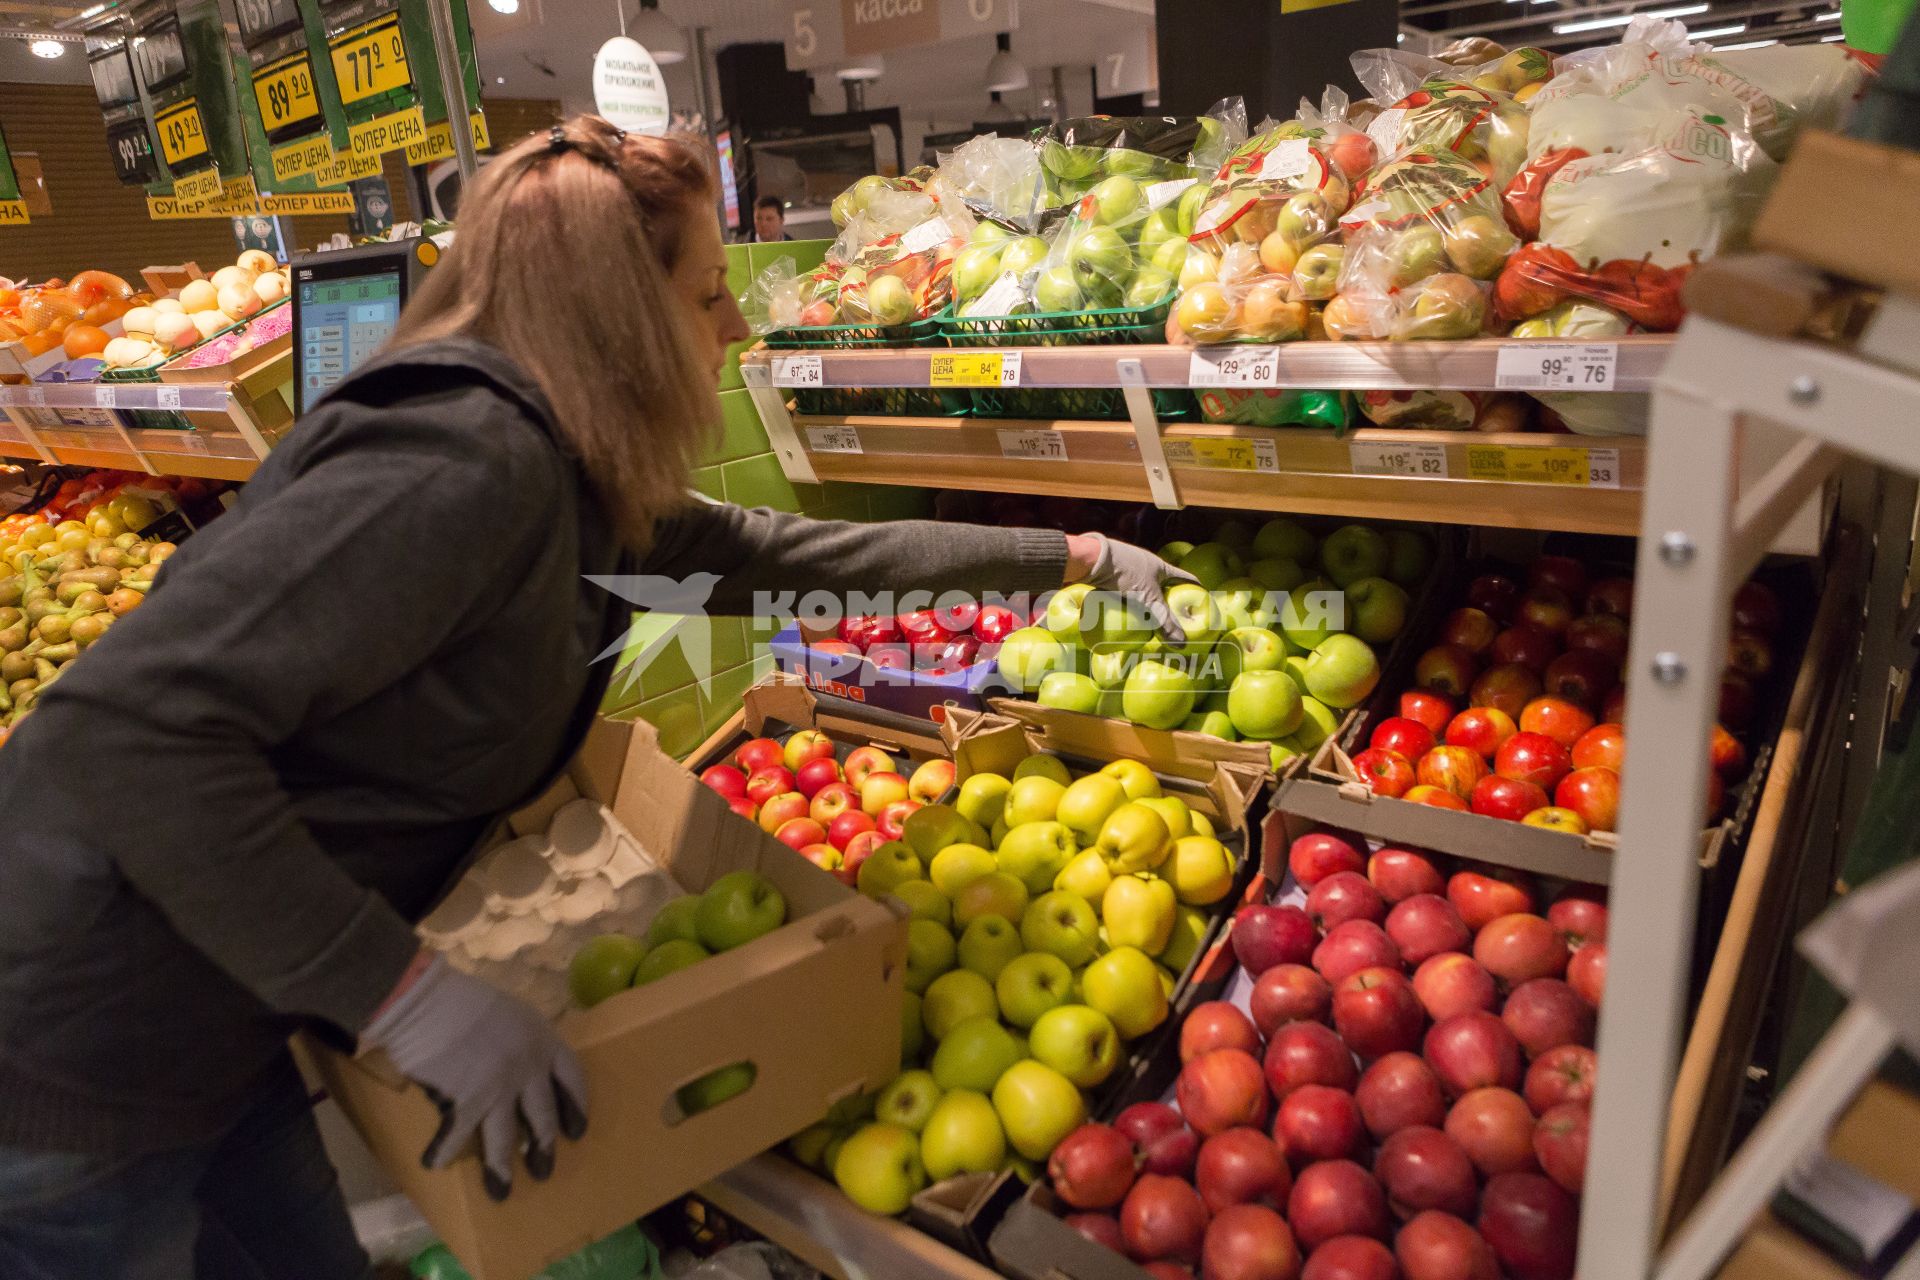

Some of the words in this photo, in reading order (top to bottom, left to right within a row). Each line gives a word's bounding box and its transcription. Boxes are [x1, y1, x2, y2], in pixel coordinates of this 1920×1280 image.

[795, 10, 816, 56] 5
[347, 46, 373, 93] 77
[1106, 52, 1124, 89] 7
[267, 79, 291, 121] 89
[167, 120, 186, 155] 49
[353, 131, 387, 155] СУПЕР
[389, 116, 422, 144] ЦЕНА
[118, 138, 136, 170] 99
[275, 155, 302, 177] СУПЕР
[303, 147, 331, 171] ЦЕНА
[349, 154, 378, 177] ЦЕНА
[176, 181, 198, 200] СУПЕР
[199, 175, 219, 195] ЦЕНА
[263, 197, 309, 213] СУПЕР
[313, 195, 351, 213] ЦЕНА
[933, 357, 954, 366] СУПЕР
[980, 363, 992, 375] 84
[1217, 360, 1239, 375] 129
[1541, 358, 1562, 375] 99
[791, 366, 800, 378] 67
[808, 369, 819, 382] 84
[932, 366, 954, 376] ЦЕНА
[1003, 369, 1016, 381] 78
[1253, 365, 1271, 381] 80
[1584, 365, 1607, 383] 76
[846, 437, 857, 449] 81
[1047, 443, 1061, 456] 77
[1256, 456, 1274, 468] 75
[1379, 454, 1404, 467] 119
[1421, 458, 1442, 474] 82
[1590, 468, 1612, 482] 33
